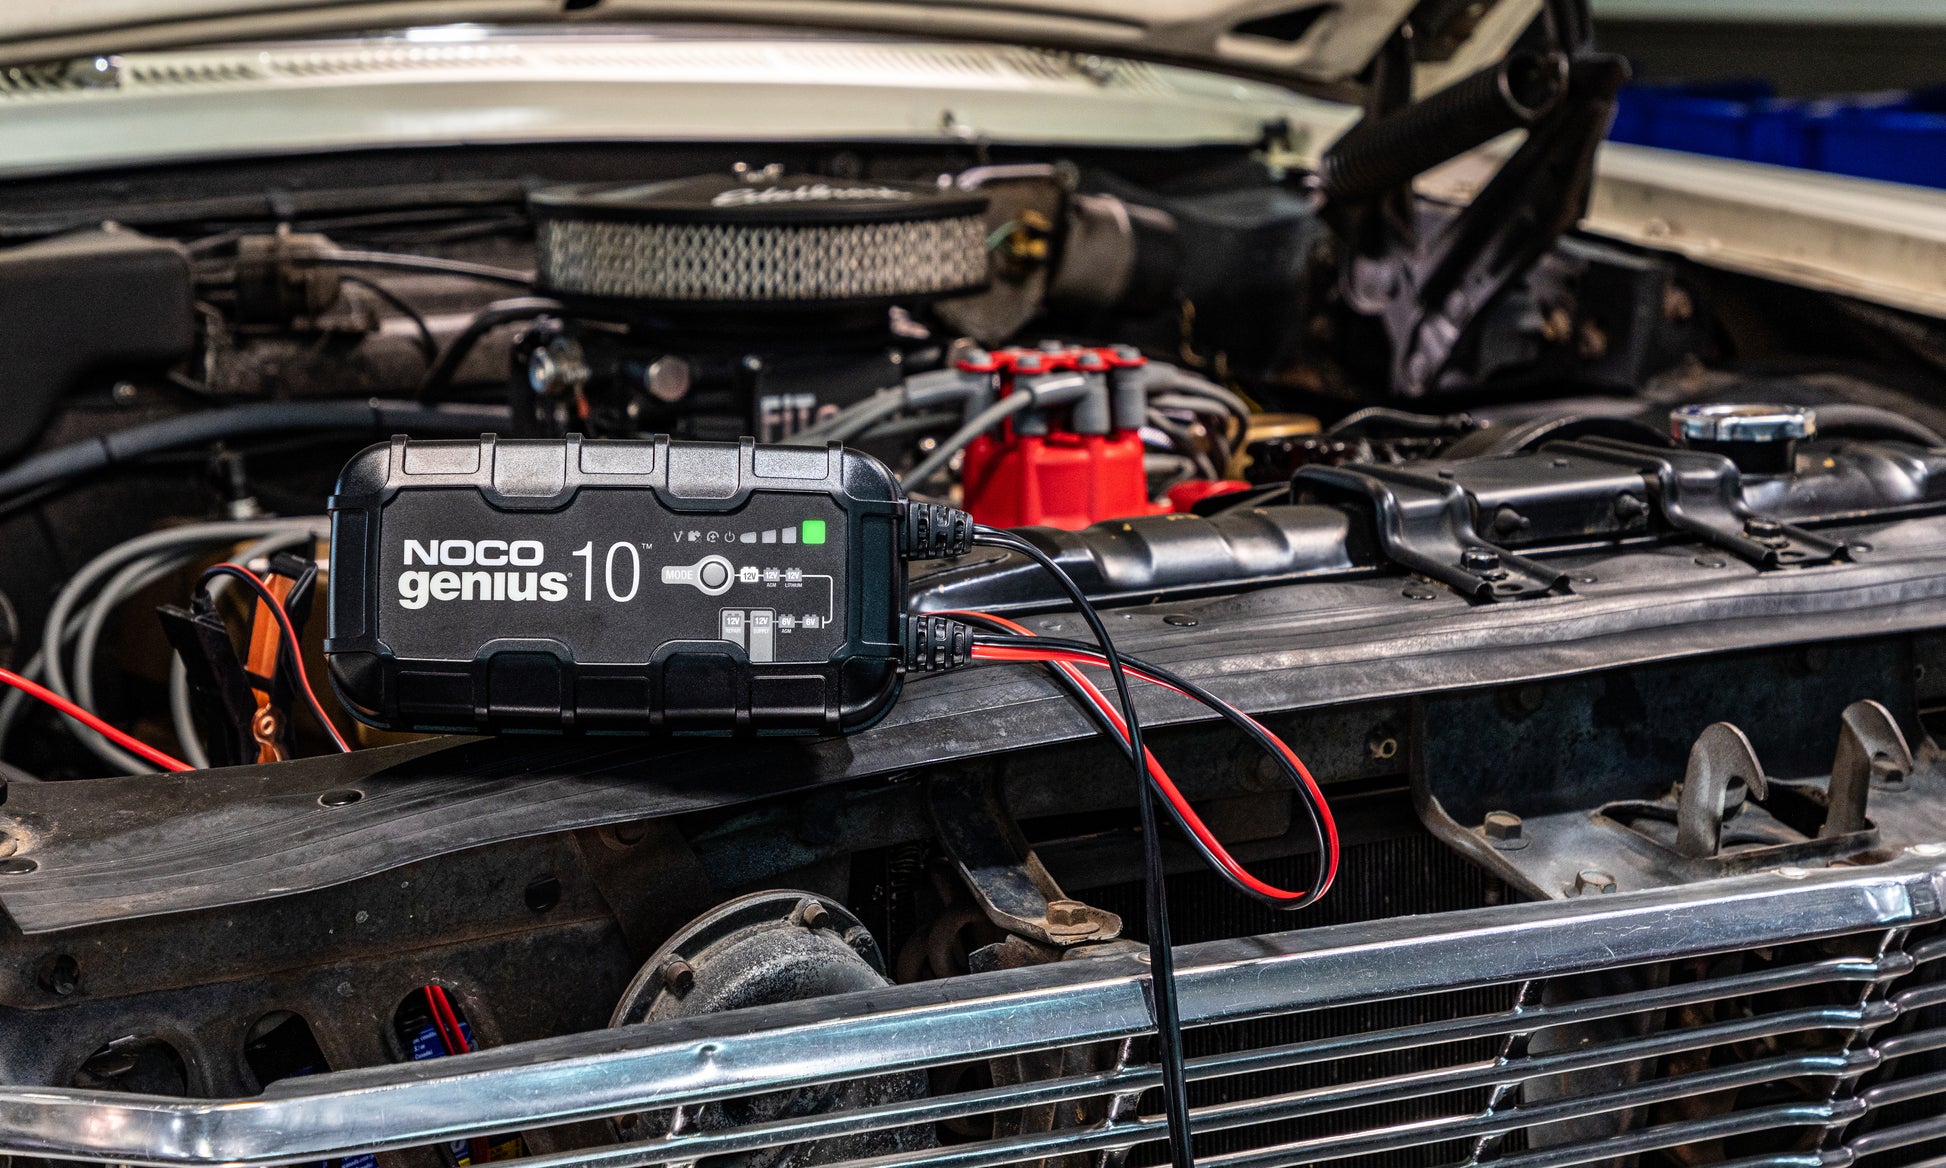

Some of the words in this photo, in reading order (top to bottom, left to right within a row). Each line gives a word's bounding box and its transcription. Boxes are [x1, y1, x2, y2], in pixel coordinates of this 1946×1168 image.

[403, 539, 544, 567] NOCO
[665, 570, 693, 580] MODE
[743, 572, 756, 581] 12V
[765, 571, 778, 579] 12V
[787, 571, 800, 579] 12V
[727, 617, 740, 625] 12V
[755, 617, 768, 625] 12V
[781, 618, 792, 626] 6V
[805, 618, 816, 626] 6V
